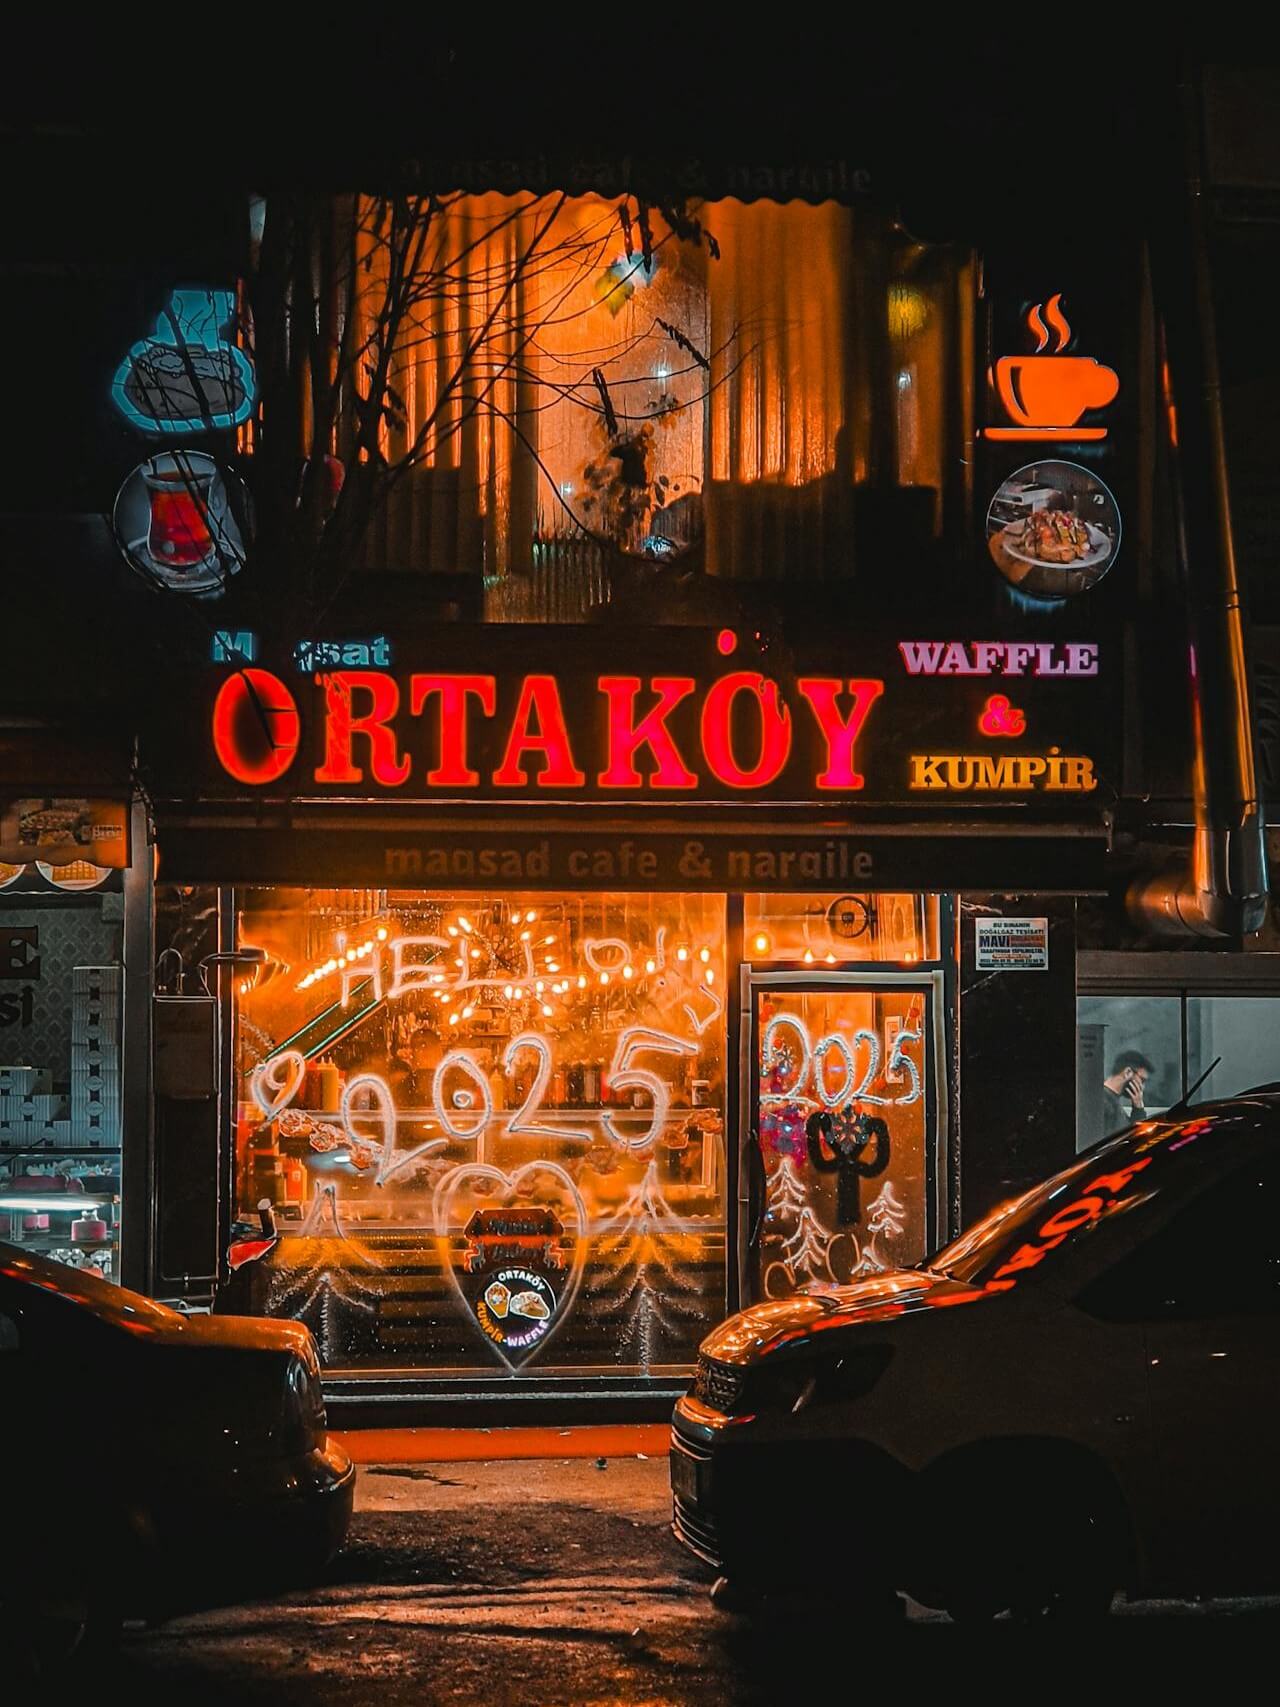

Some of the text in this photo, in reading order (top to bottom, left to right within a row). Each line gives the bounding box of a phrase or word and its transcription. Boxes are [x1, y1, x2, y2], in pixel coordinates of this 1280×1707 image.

[898, 641, 1099, 677] WAFFLE
[213, 629, 885, 789] ORTAKÖY
[978, 694, 1026, 736] &
[909, 746, 1099, 791] KUMPİR
[567, 841, 658, 879] cafe
[679, 841, 712, 879] &
[758, 1012, 923, 1107] 2025
[339, 1027, 700, 1187] 2025
[497, 1269, 546, 1292] ORTAKÖY
